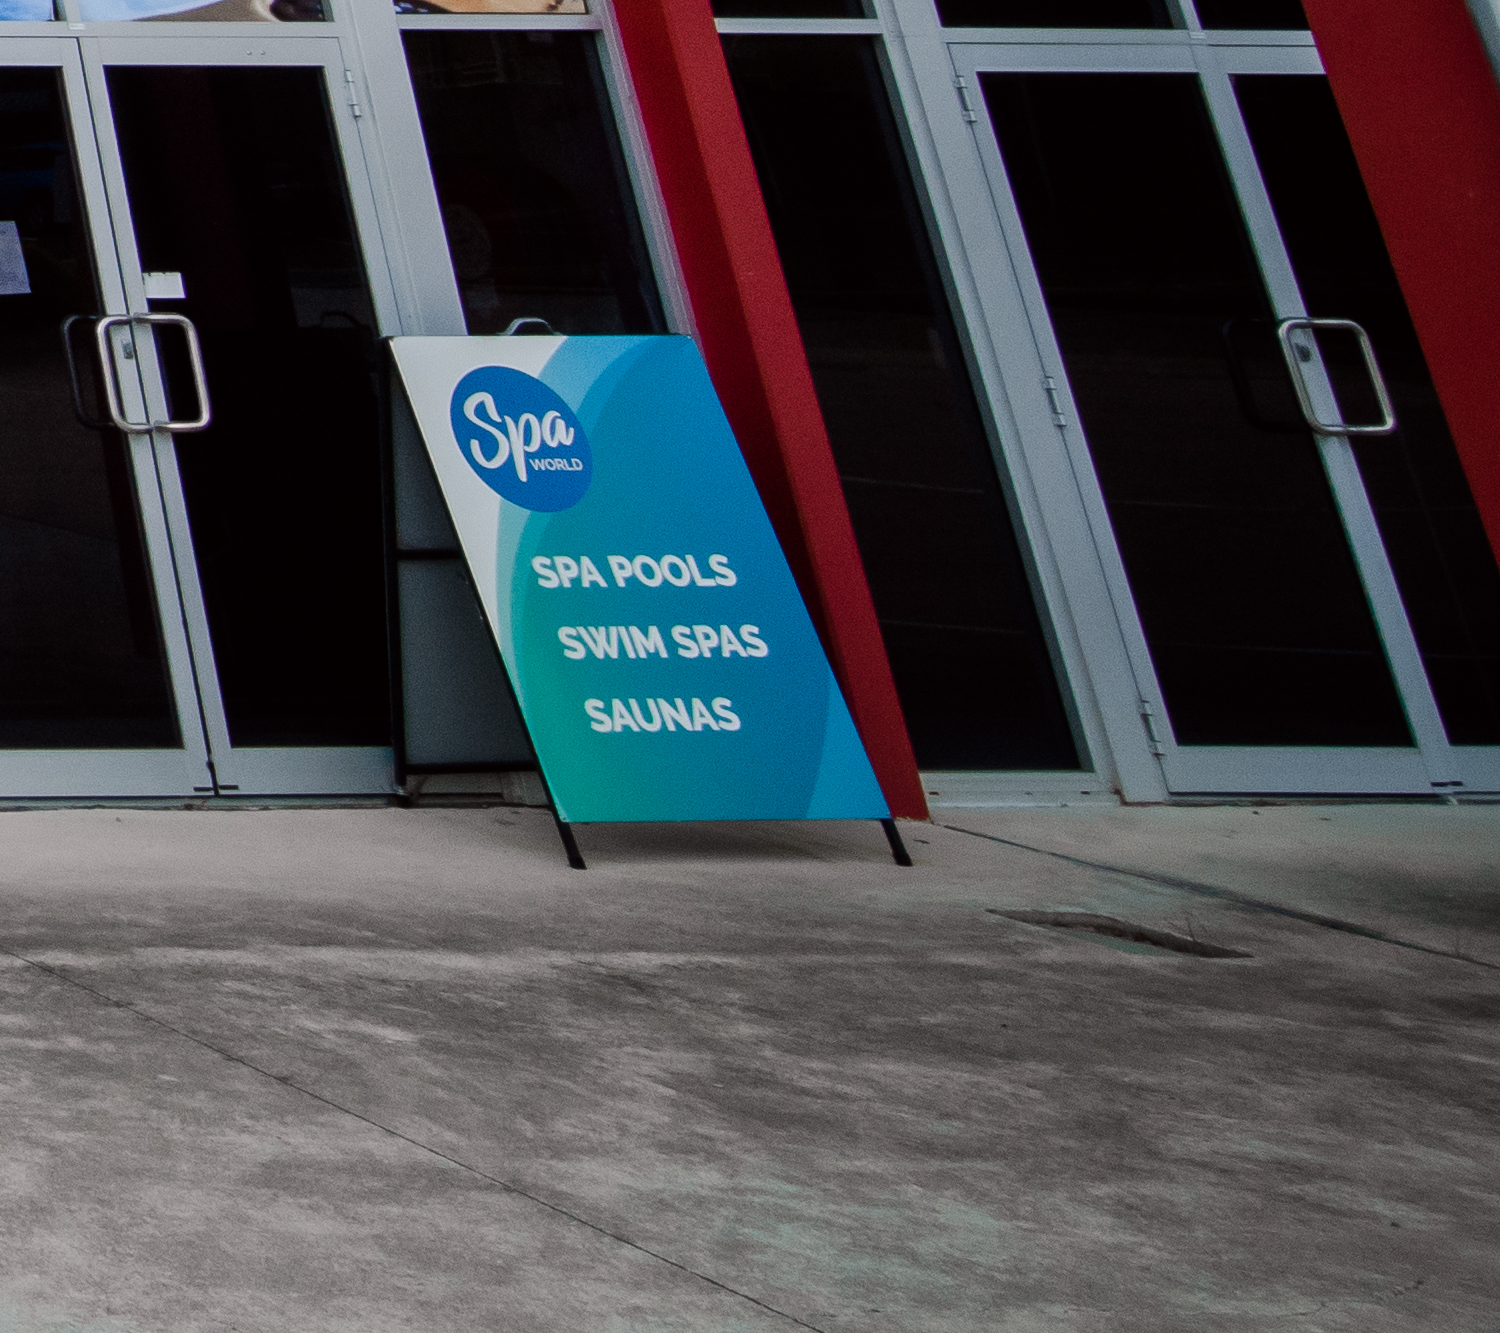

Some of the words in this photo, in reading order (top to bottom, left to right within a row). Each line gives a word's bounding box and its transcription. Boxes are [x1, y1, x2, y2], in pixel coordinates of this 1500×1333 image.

[463, 392, 574, 482] Spa
[529, 458, 583, 471] WORLD
[531, 556, 607, 588] SPA
[609, 554, 737, 587] POOLS
[557, 626, 668, 659] SWIM
[671, 625, 769, 658] SPAS
[584, 698, 741, 733] SAUNAS
